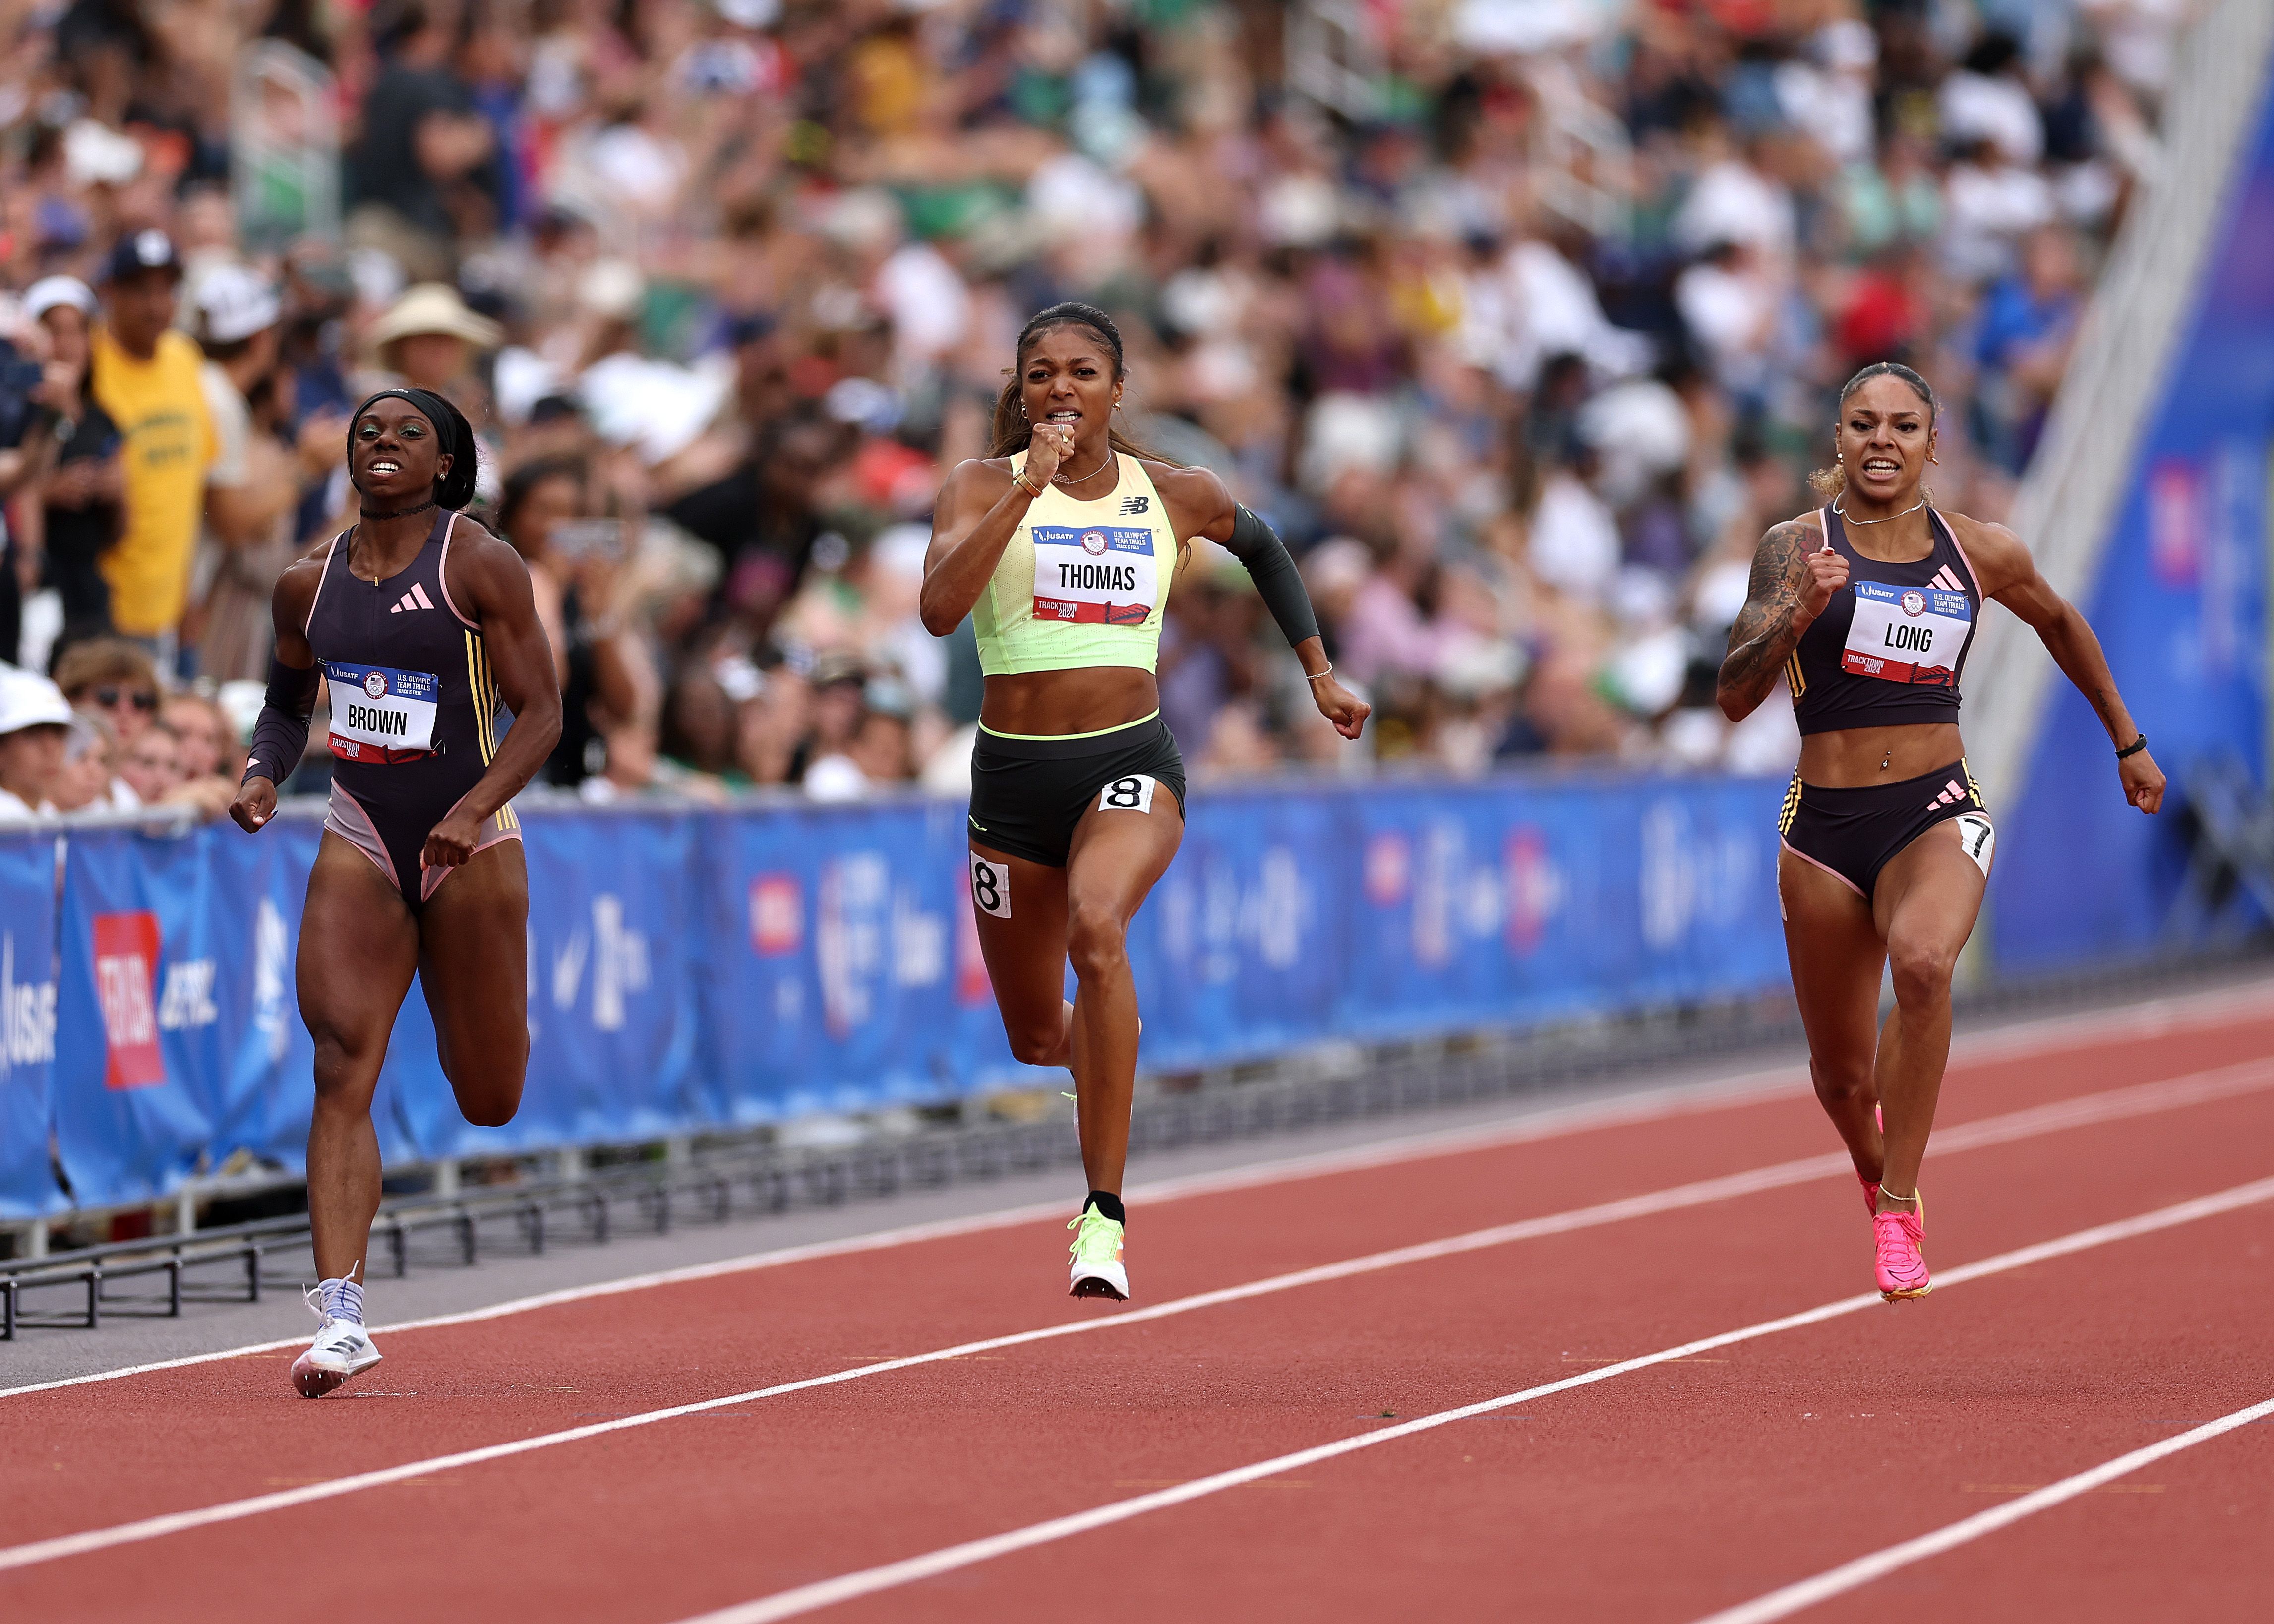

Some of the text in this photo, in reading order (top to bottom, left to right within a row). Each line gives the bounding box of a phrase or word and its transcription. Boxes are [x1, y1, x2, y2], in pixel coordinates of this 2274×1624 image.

[1058, 564, 1135, 591] THOMAS
[1872, 589, 1894, 598] USATF
[1945, 594, 1965, 603] OLYMPIC
[1038, 601, 1077, 612] TRACKTOWN
[1948, 601, 1965, 610] TRIALS
[1058, 610, 1075, 618] 2024
[1884, 623, 1933, 653] LONG
[1847, 654, 1885, 668] TRACKTOWN
[1864, 664, 1880, 674] 2024
[409, 675, 430, 685] OLYMPIC
[412, 683, 430, 691] TRIALS
[349, 704, 407, 736] BROWN
[332, 738, 359, 751] TRACKTOWN
[346, 749, 358, 758] 2024
[1107, 778, 1142, 807] 8
[1963, 818, 1990, 859] 7
[974, 861, 1001, 911] 8
